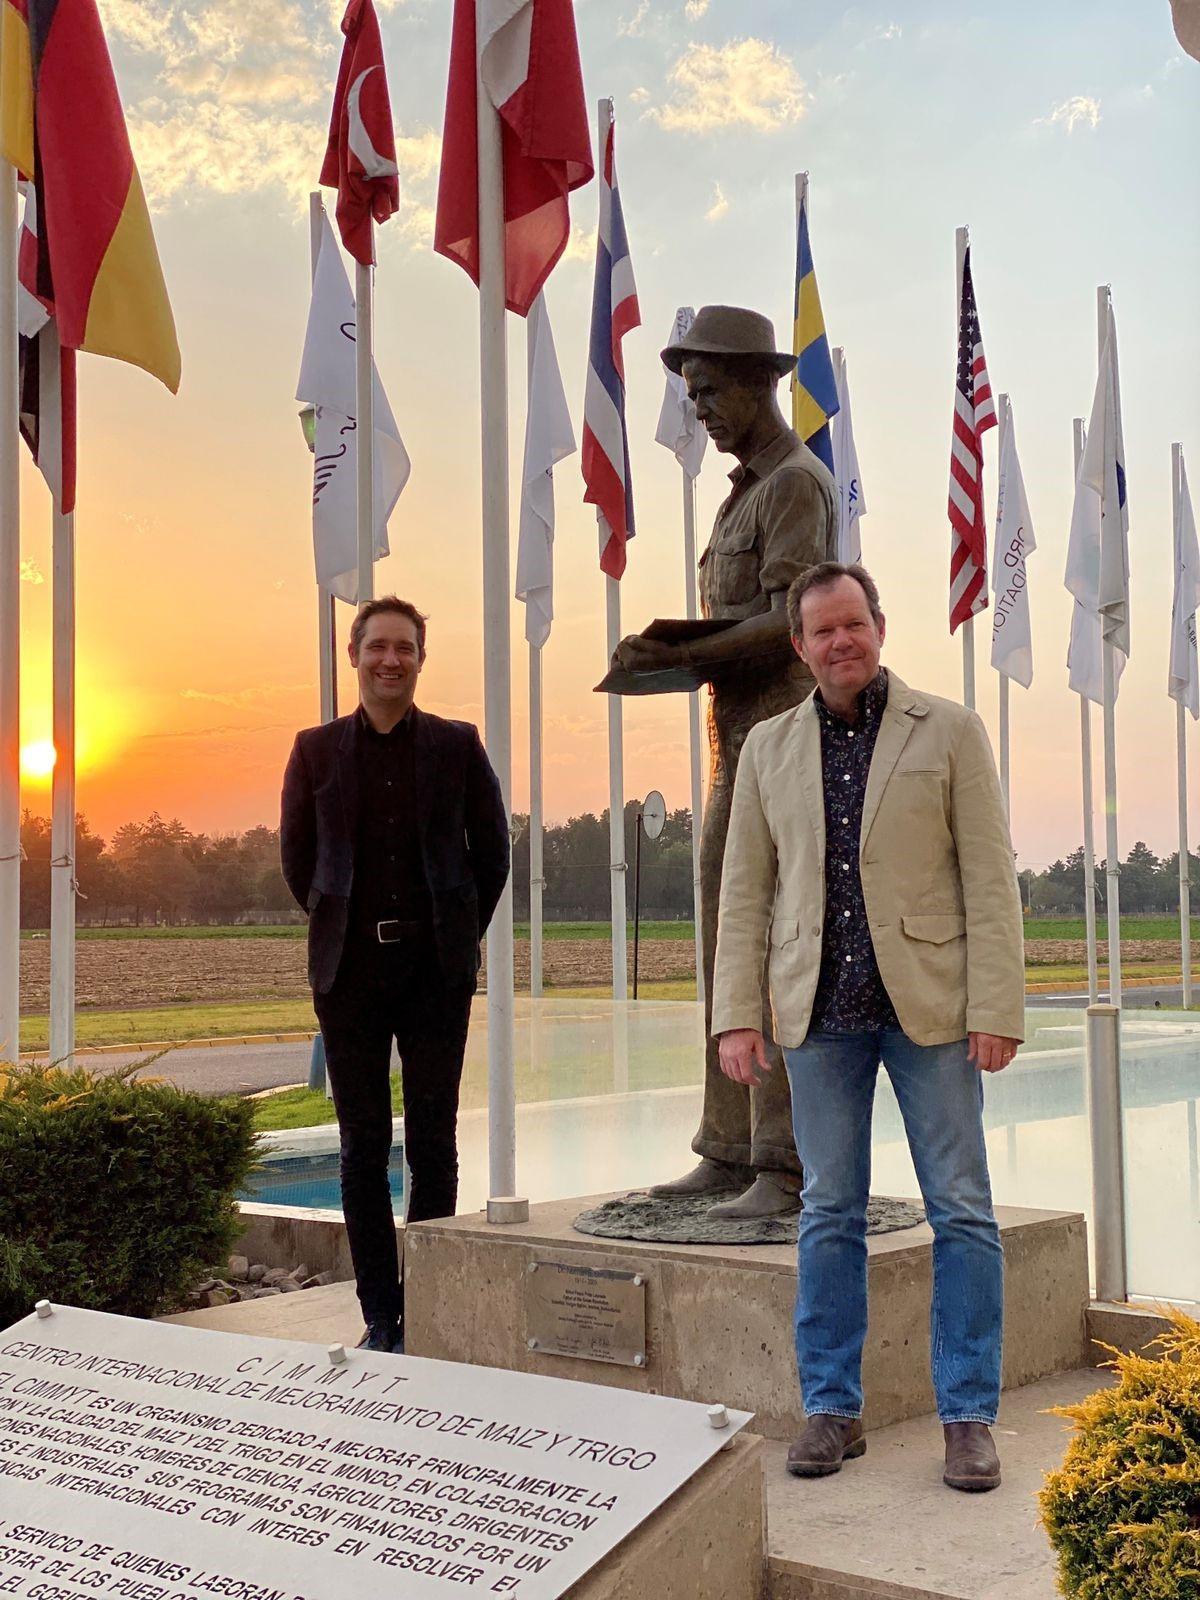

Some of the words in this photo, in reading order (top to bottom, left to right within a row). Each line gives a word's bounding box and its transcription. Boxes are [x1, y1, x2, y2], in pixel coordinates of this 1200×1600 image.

[1, 1341, 82, 1367] CENTRO
[74, 1355, 231, 1394] INTERNACIONAL
[225, 1380, 269, 1399] DE
[259, 1385, 442, 1428] MEJORAMIENTO
[437, 1414, 484, 1436] DE
[475, 1421, 549, 1448] MAIZ
[544, 1433, 573, 1452] Y
[568, 1438, 657, 1471] TRIGO
[12, 1378, 100, 1405] CIMMYT
[87, 1396, 115, 1410] ES
[111, 1400, 141, 1414] UN
[135, 1405, 232, 1431] ORGANISMO
[227, 1422, 318, 1447] DEDICADO
[312, 1437, 332, 1451] A
[329, 1440, 422, 1468] MEJORAR
[418, 1457, 589, 1503] PRINCIPALMENTE
[585, 1492, 618, 1511] LA
[16, 1401, 36, 1413] Y
[26, 1404, 53, 1418] LA
[48, 1409, 116, 1430] CALIDAD
[109, 1421, 145, 1437] DEL
[140, 1426, 188, 1444] MAIZ
[181, 1433, 202, 1446] Y
[193, 1436, 229, 1453] DEL
[228, 1442, 285, 1463] TRIGO
[279, 1453, 312, 1469] EN
[305, 1458, 332, 1474] EL
[331, 1463, 403, 1491] MUNDO,
[403, 1478, 439, 1495] EN
[434, 1485, 599, 1531] COLABORACION
[13, 1443, 35, 1455] E
[27, 1446, 140, 1479] INDUSTRIALES.
[145, 1471, 185, 1489] SUS
[179, 1478, 294, 1513] PROGRAMAS
[290, 1502, 337, 1524] SON
[331, 1512, 466, 1553] FINANCIADOS
[463, 1541, 514, 1565] POR
[513, 1553, 552, 1574] UN
[32, 1426, 131, 1457] NACIONALES,
[128, 1445, 213, 1471] HOMBRES
[205, 1461, 239, 1477] DE
[232, 1466, 304, 1494] CIENCIA,
[301, 1481, 449, 1526] AGRICULTORES,
[447, 1512, 574, 1552] DIRIGENTES
[46, 1472, 197, 1516] INTERNACIONALES
[200, 1507, 246, 1527] CON
[247, 1518, 331, 1548] INTERES
[333, 1538, 370, 1557] EN
[372, 1547, 485, 1585] RESOLVER
[0, 1575, 26, 1594] EL
[4, 1524, 84, 1554] SERVICIO
[80, 1543, 115, 1561] DE
[110, 1551, 192, 1582] QUIENES
[41, 1559, 75, 1578] DE
[68, 1567, 112, 1588] LOS
